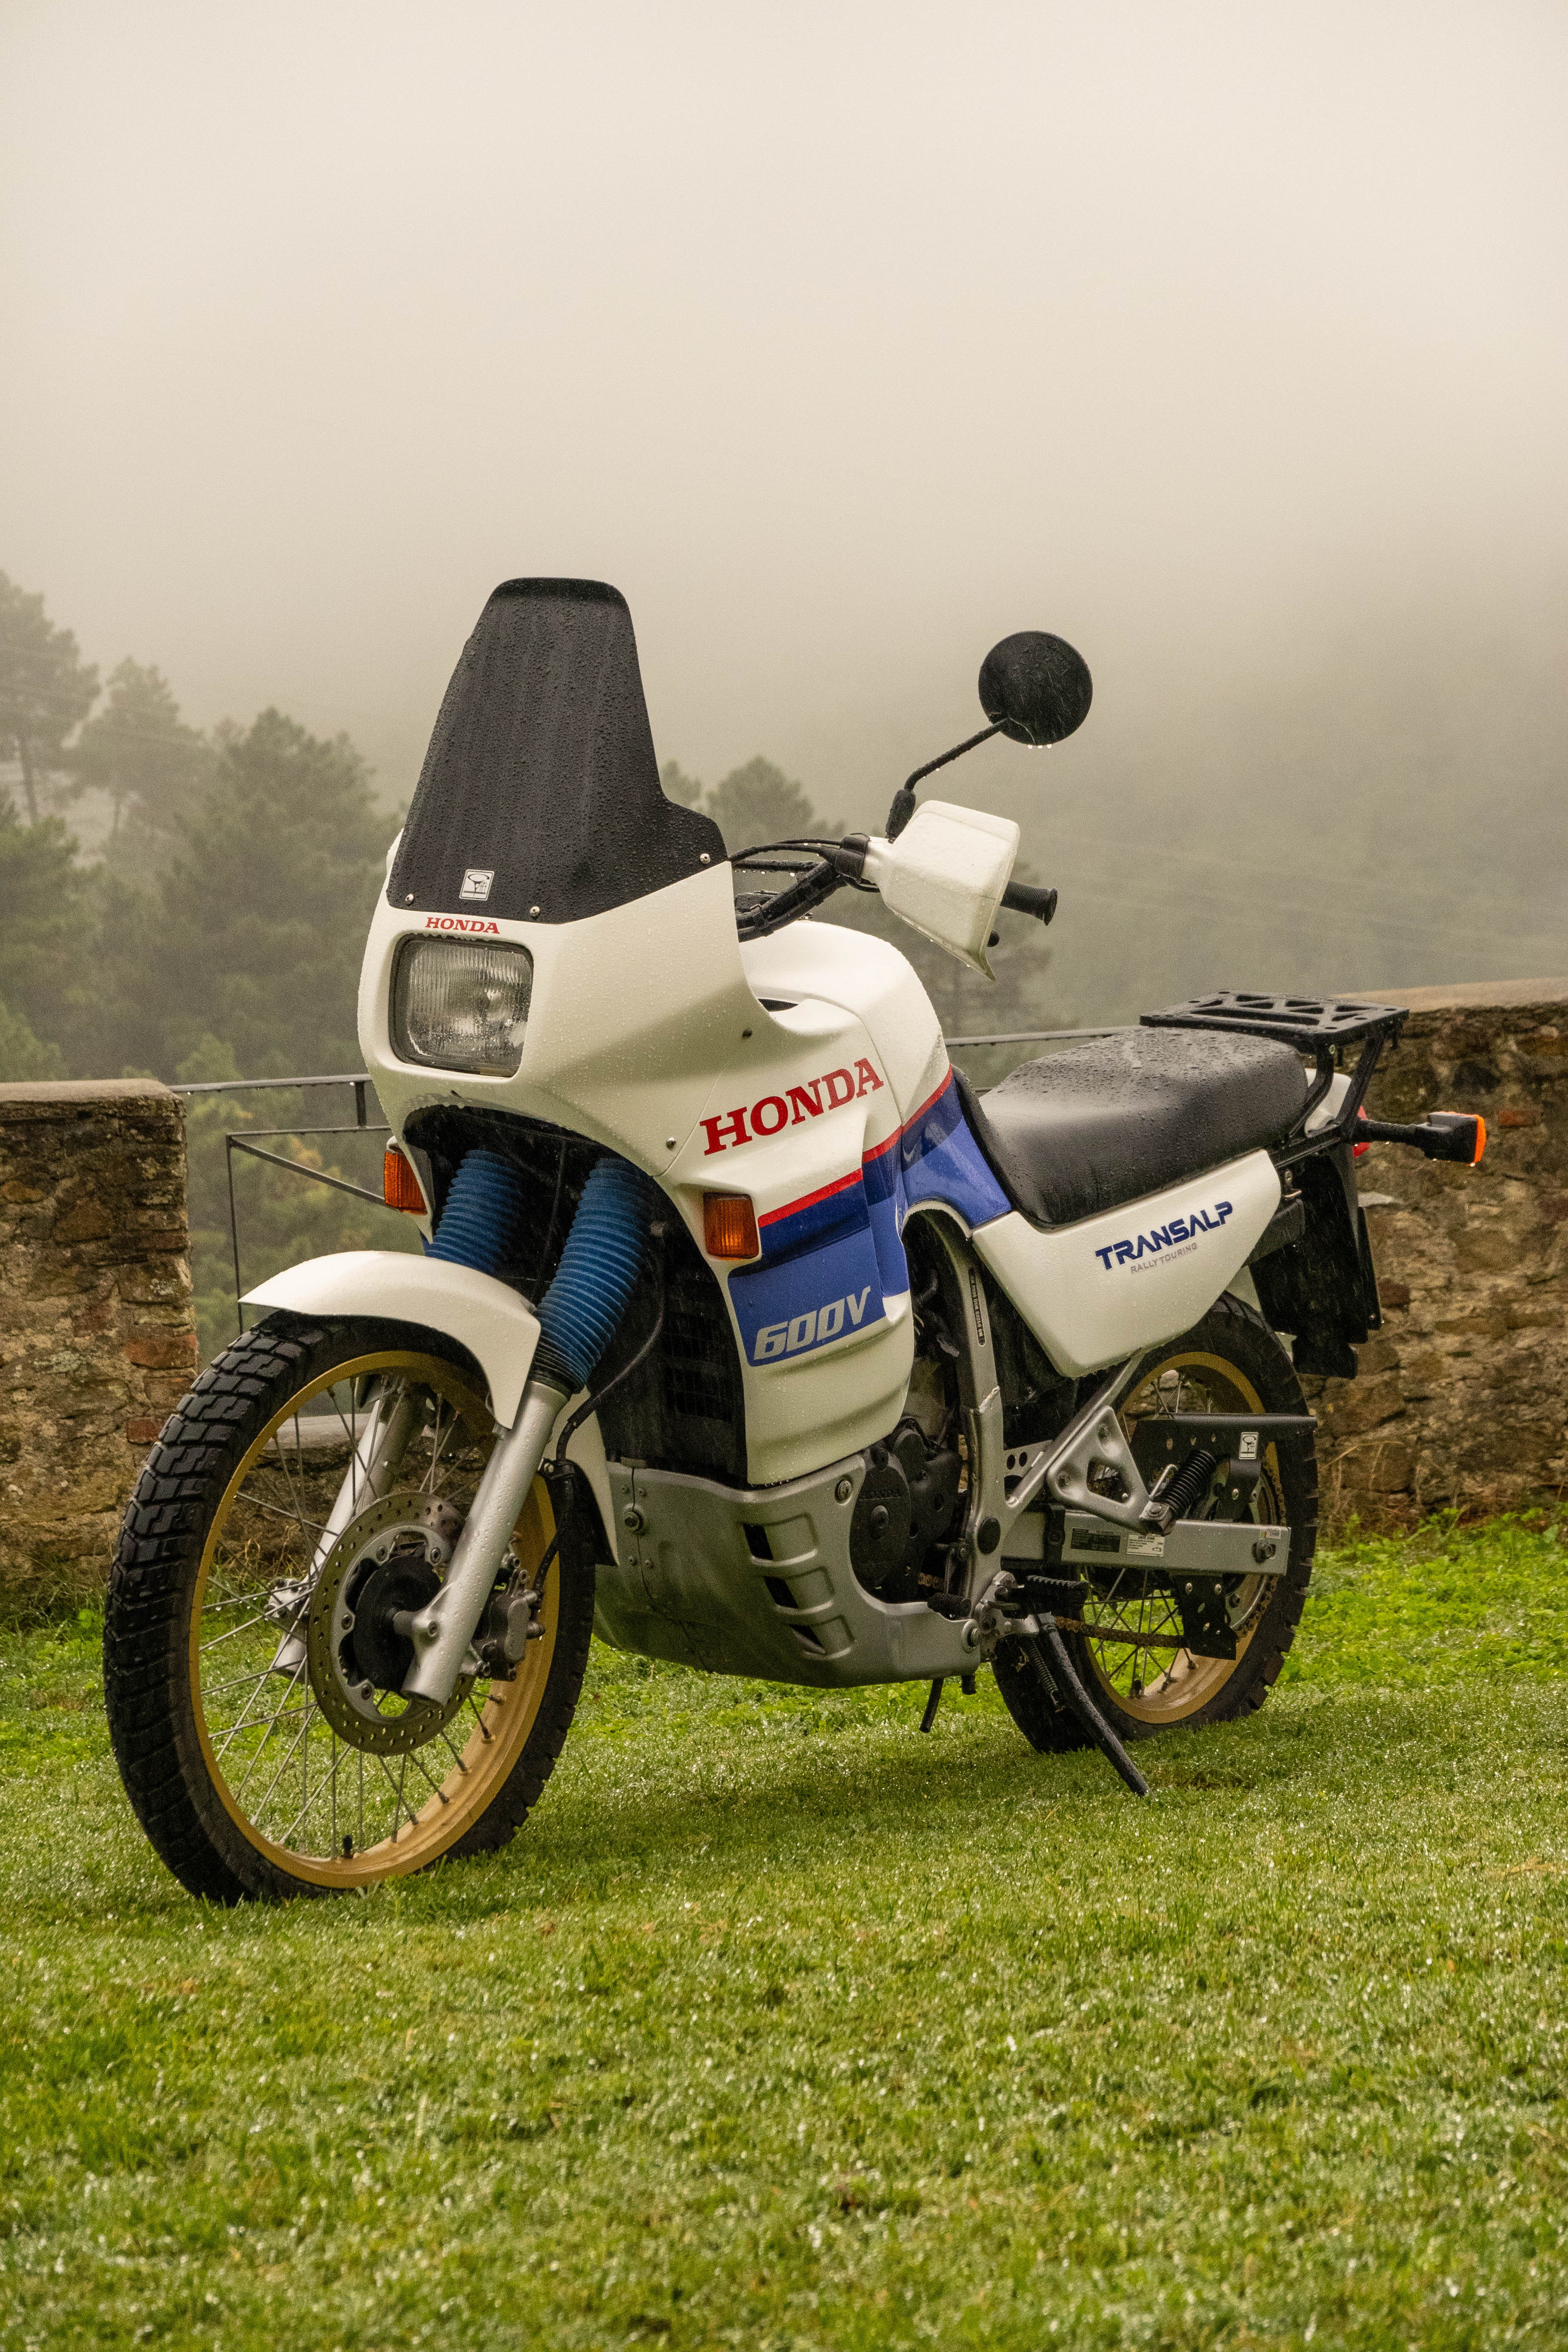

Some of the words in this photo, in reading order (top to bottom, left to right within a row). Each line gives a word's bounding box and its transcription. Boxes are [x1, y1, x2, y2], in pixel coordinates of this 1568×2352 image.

[425, 917, 500, 934] HONDA
[700, 1058, 884, 1155] HONDA
[1095, 1201, 1233, 1270] TRANSALP
[1130, 1259, 1158, 1273] RALLY
[1158, 1243, 1197, 1265] TOURING
[753, 1286, 871, 1361] 600V
